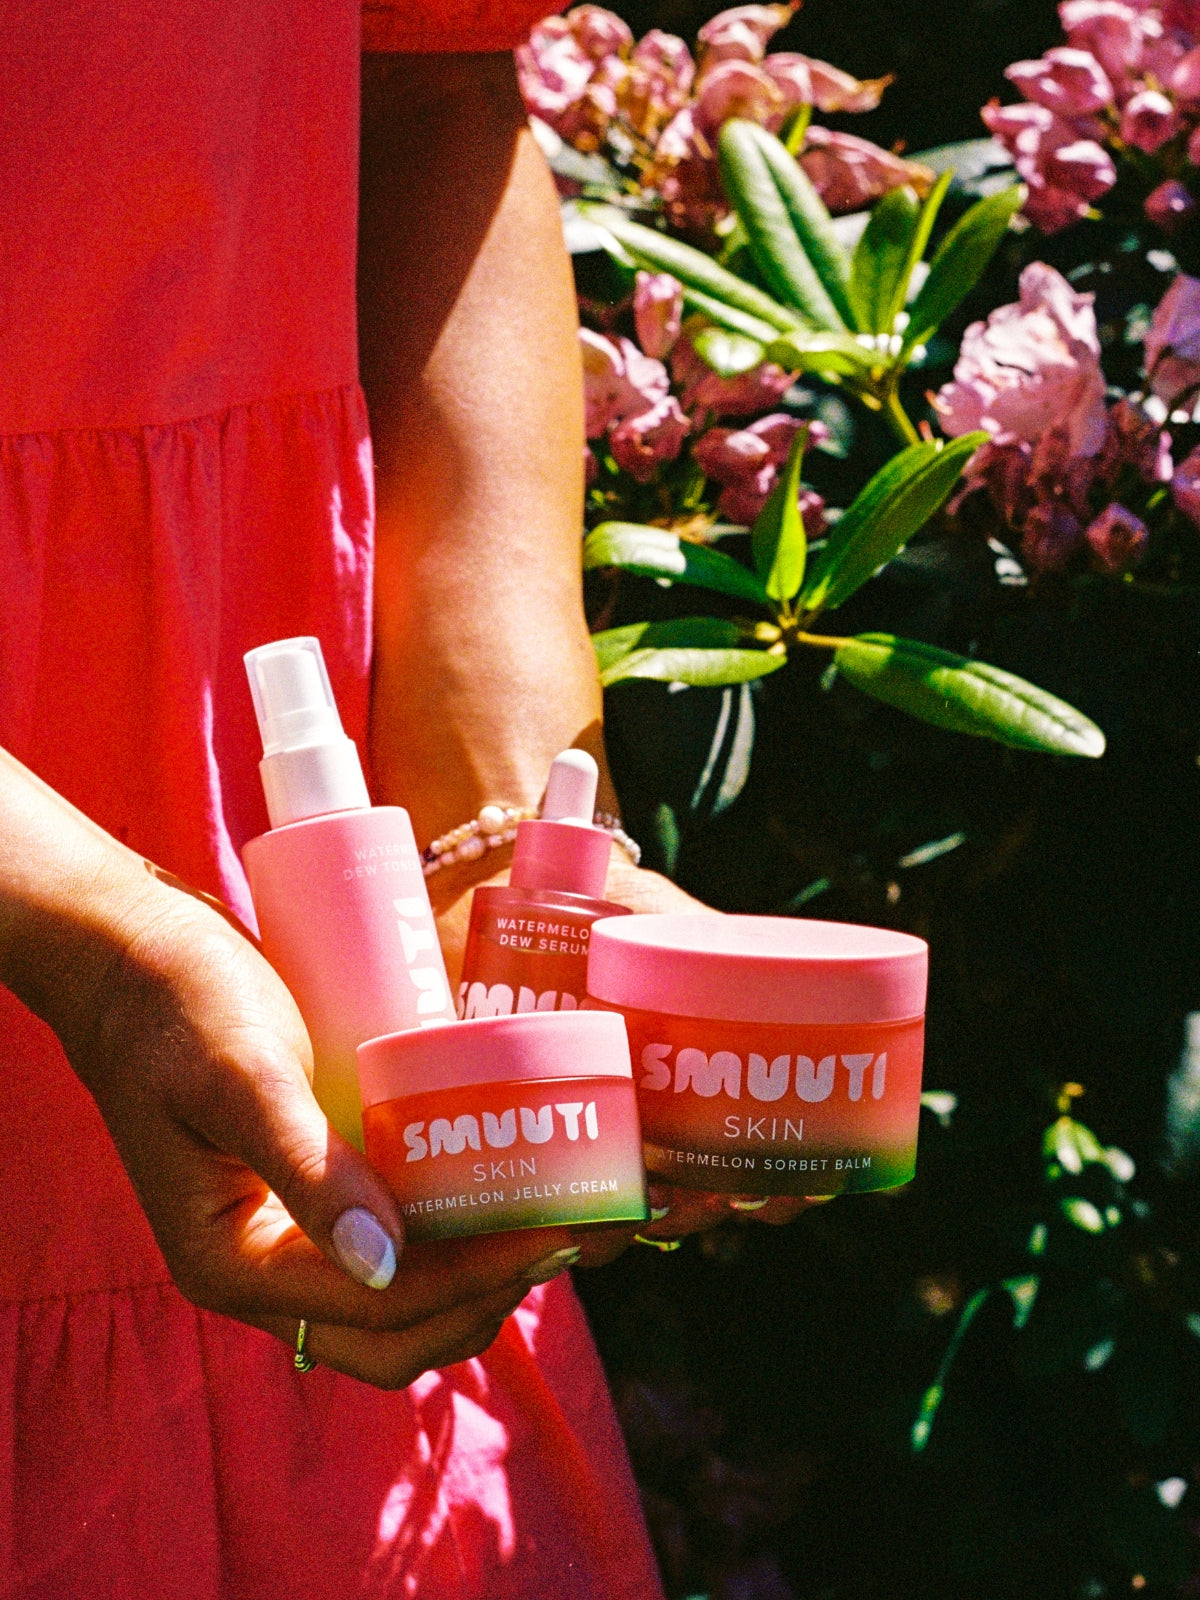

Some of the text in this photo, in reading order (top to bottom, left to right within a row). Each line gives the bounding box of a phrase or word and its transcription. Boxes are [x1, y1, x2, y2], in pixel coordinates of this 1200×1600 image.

[343, 864, 377, 881] DEW
[499, 934, 589, 956] DEW SERUM
[640, 1043, 888, 1103] SMUUTI
[403, 1101, 599, 1163] SMUUTI
[723, 1115, 804, 1141] SKIN
[473, 1157, 537, 1183] SKIN
[655, 1149, 872, 1171] ATERMELON SORBET BALM
[513, 1183, 562, 1201] JELLY
[570, 1179, 619, 1195] CREAM
